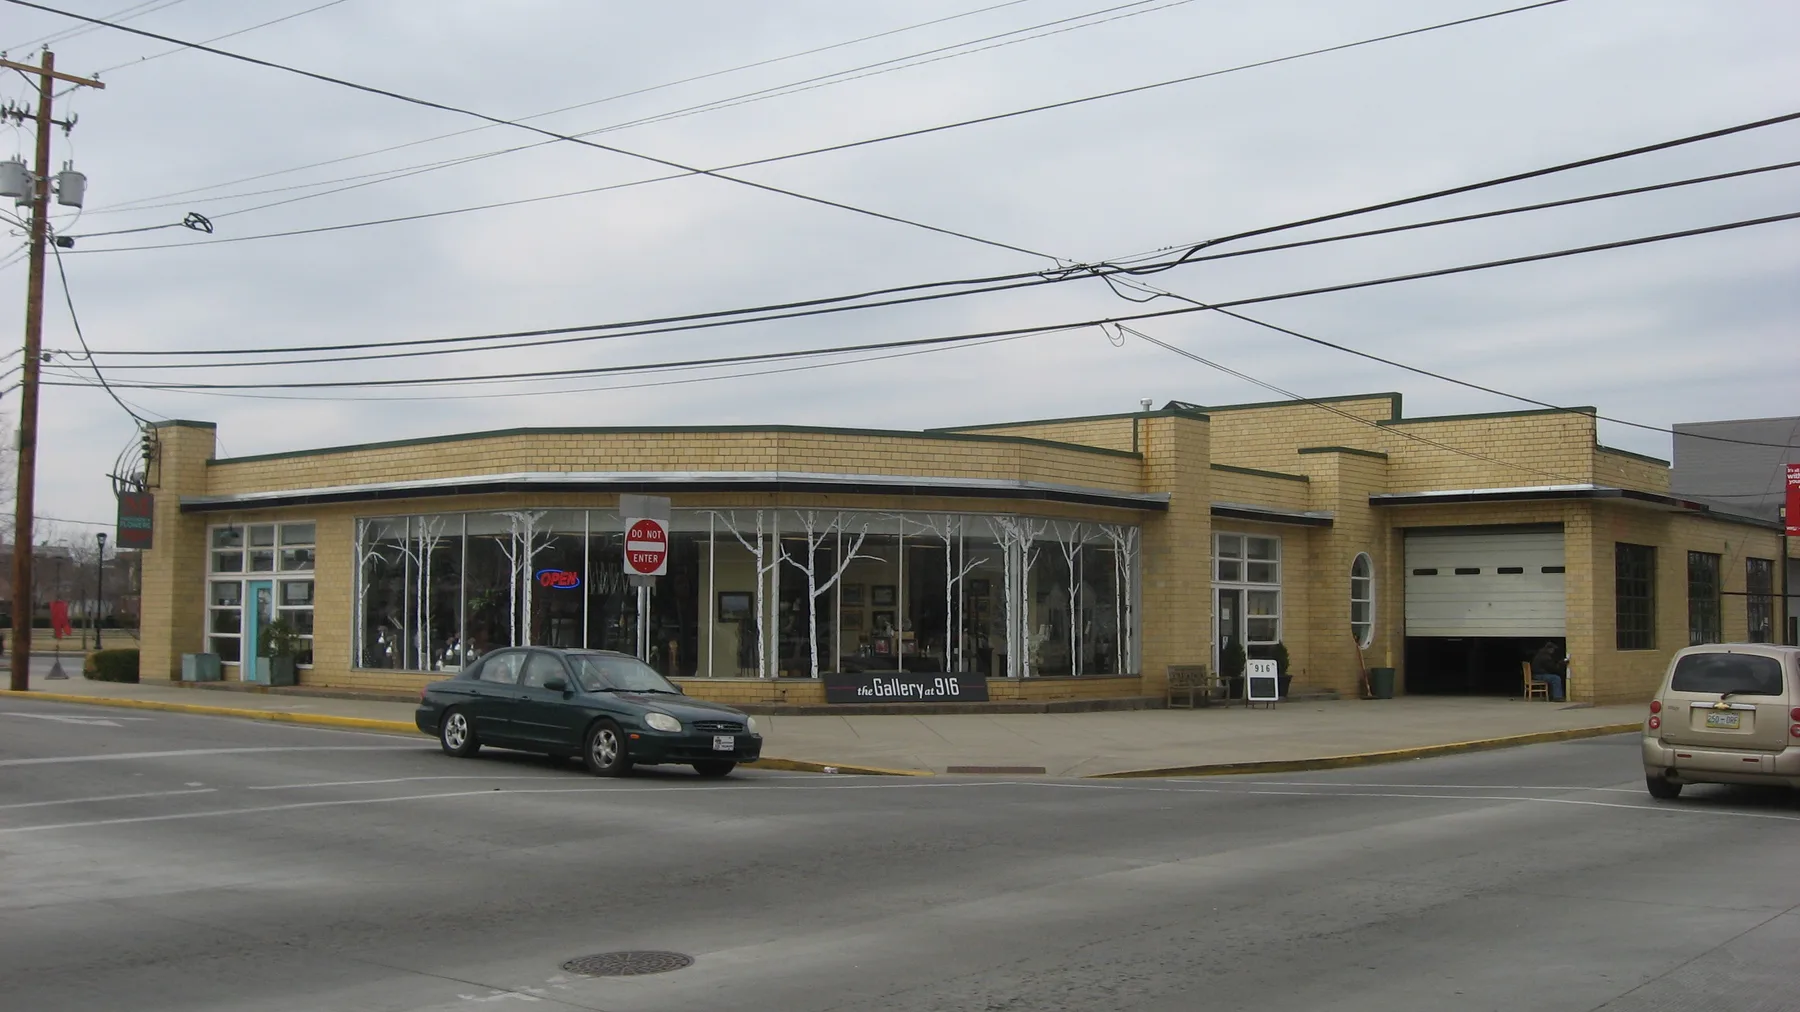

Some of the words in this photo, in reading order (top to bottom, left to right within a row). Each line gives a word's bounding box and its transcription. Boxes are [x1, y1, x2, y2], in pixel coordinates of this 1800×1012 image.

[631, 530, 643, 538] DO
[646, 530, 662, 539] NOT
[633, 553, 659, 563] ENTER
[540, 572, 577, 587] OPEN
[1254, 664, 1271, 672] 916
[857, 685, 874, 696] the
[873, 678, 924, 699] Gallery
[924, 686, 935, 696] at
[934, 677, 960, 696] 916
